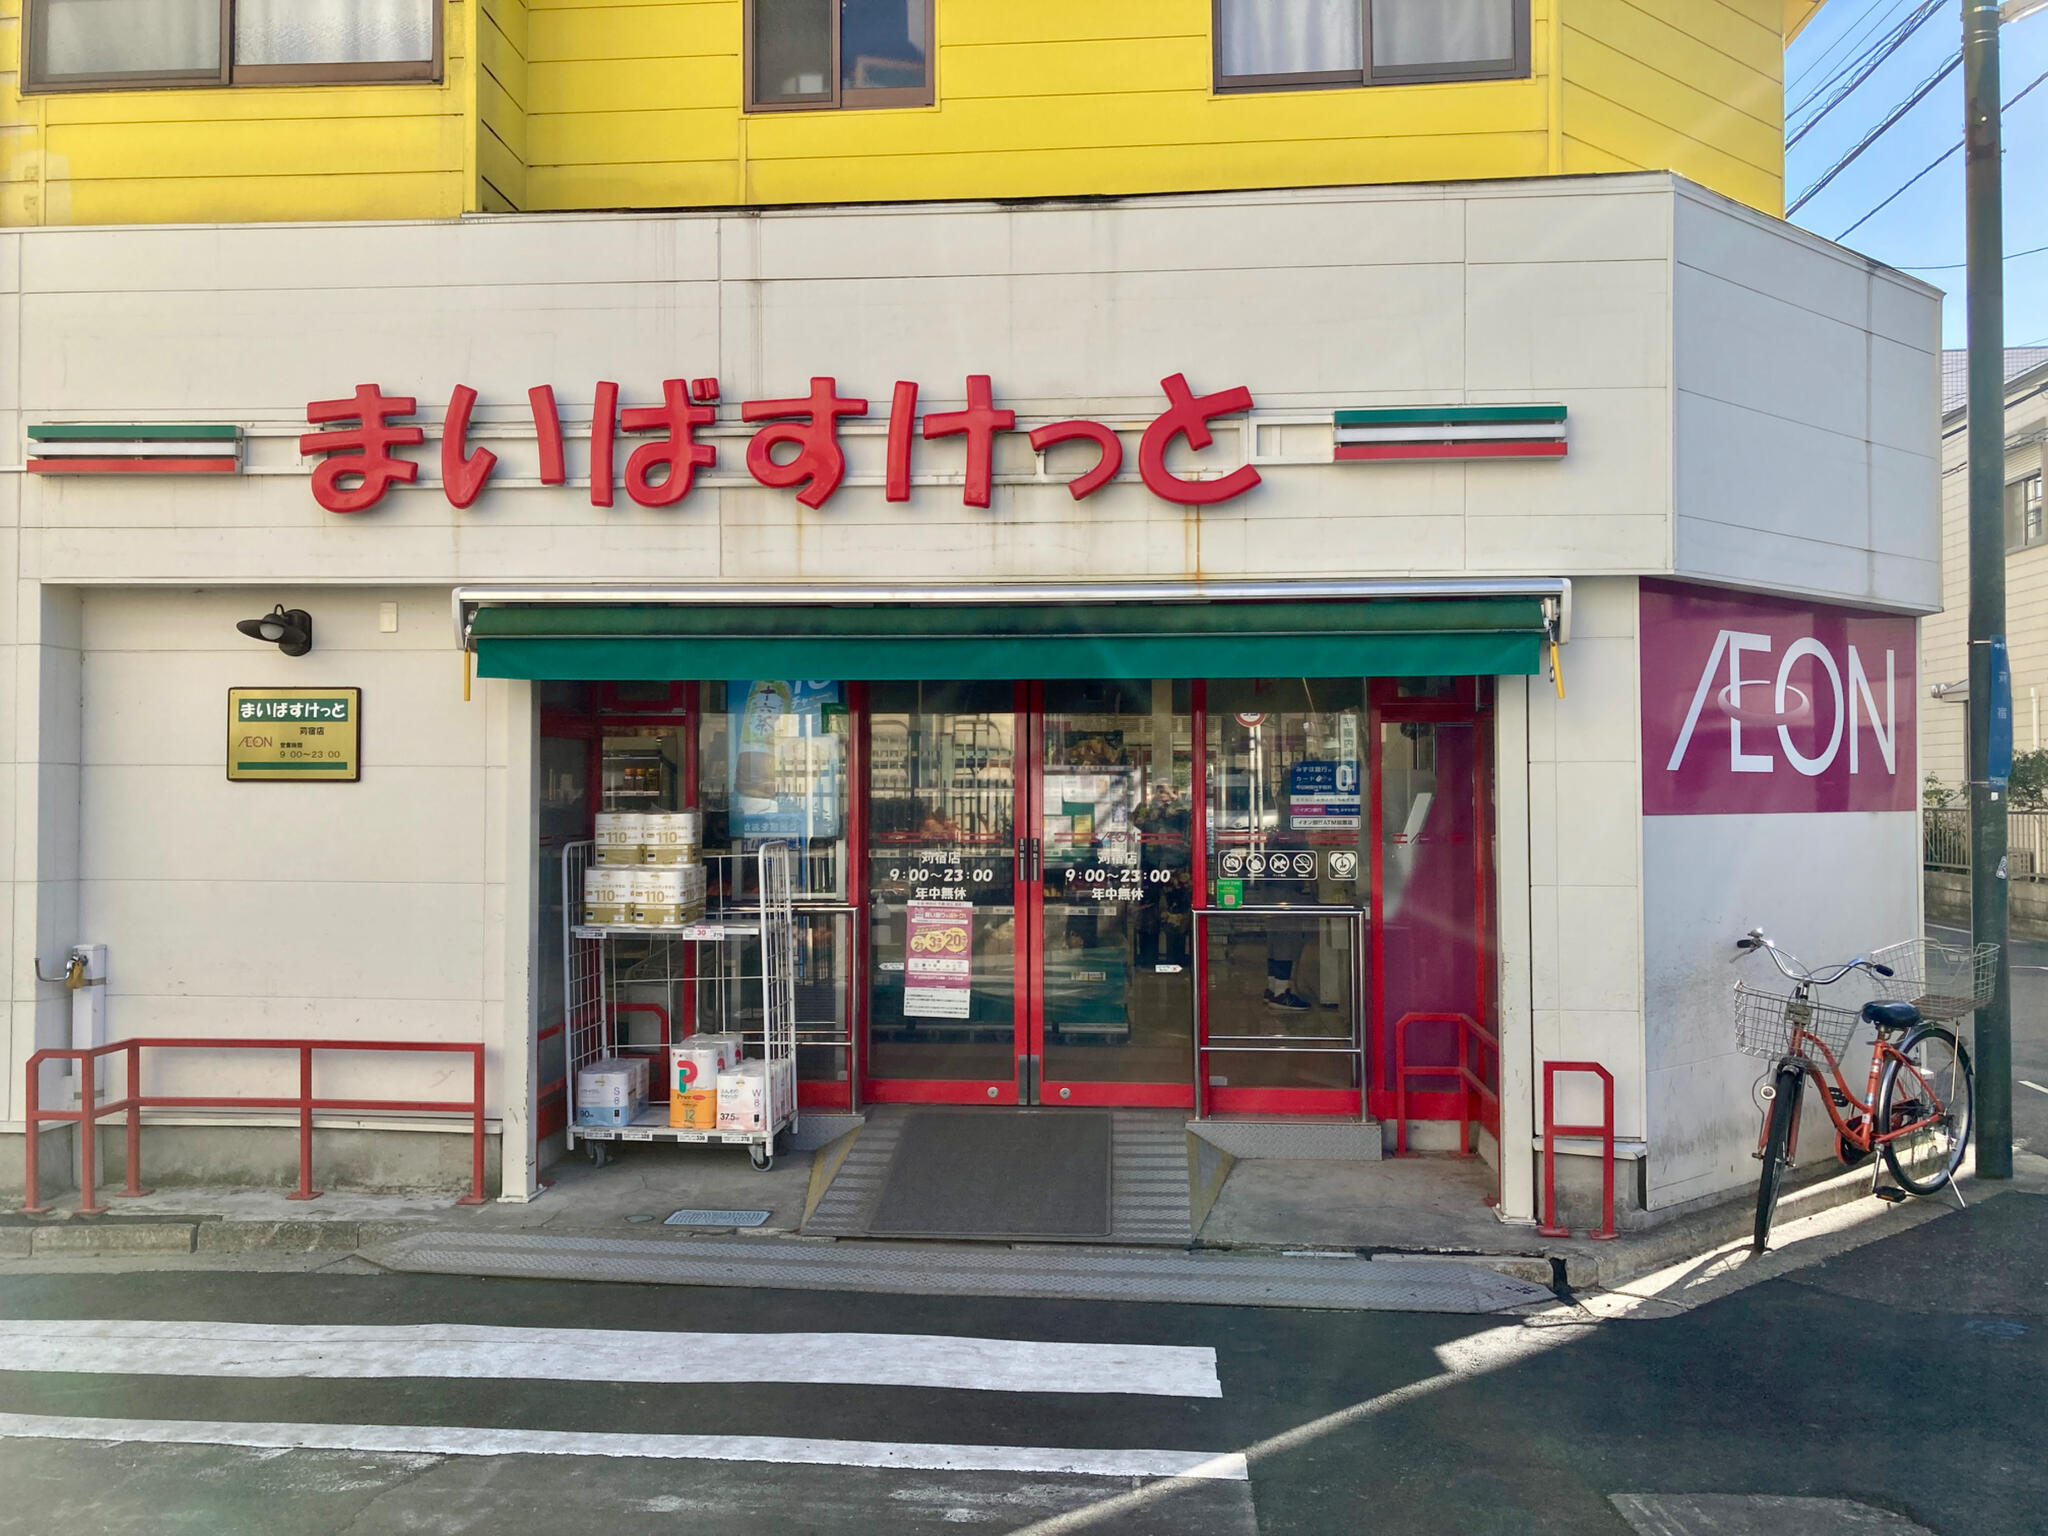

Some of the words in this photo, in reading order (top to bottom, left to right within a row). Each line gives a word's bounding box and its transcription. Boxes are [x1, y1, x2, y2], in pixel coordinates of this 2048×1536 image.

[299, 372, 1261, 513] まいばすけっと
[240, 702, 346, 718] まいばすけっと
[915, 887, 967, 900] 年中無休
[1091, 887, 1144, 901] 年中無休
